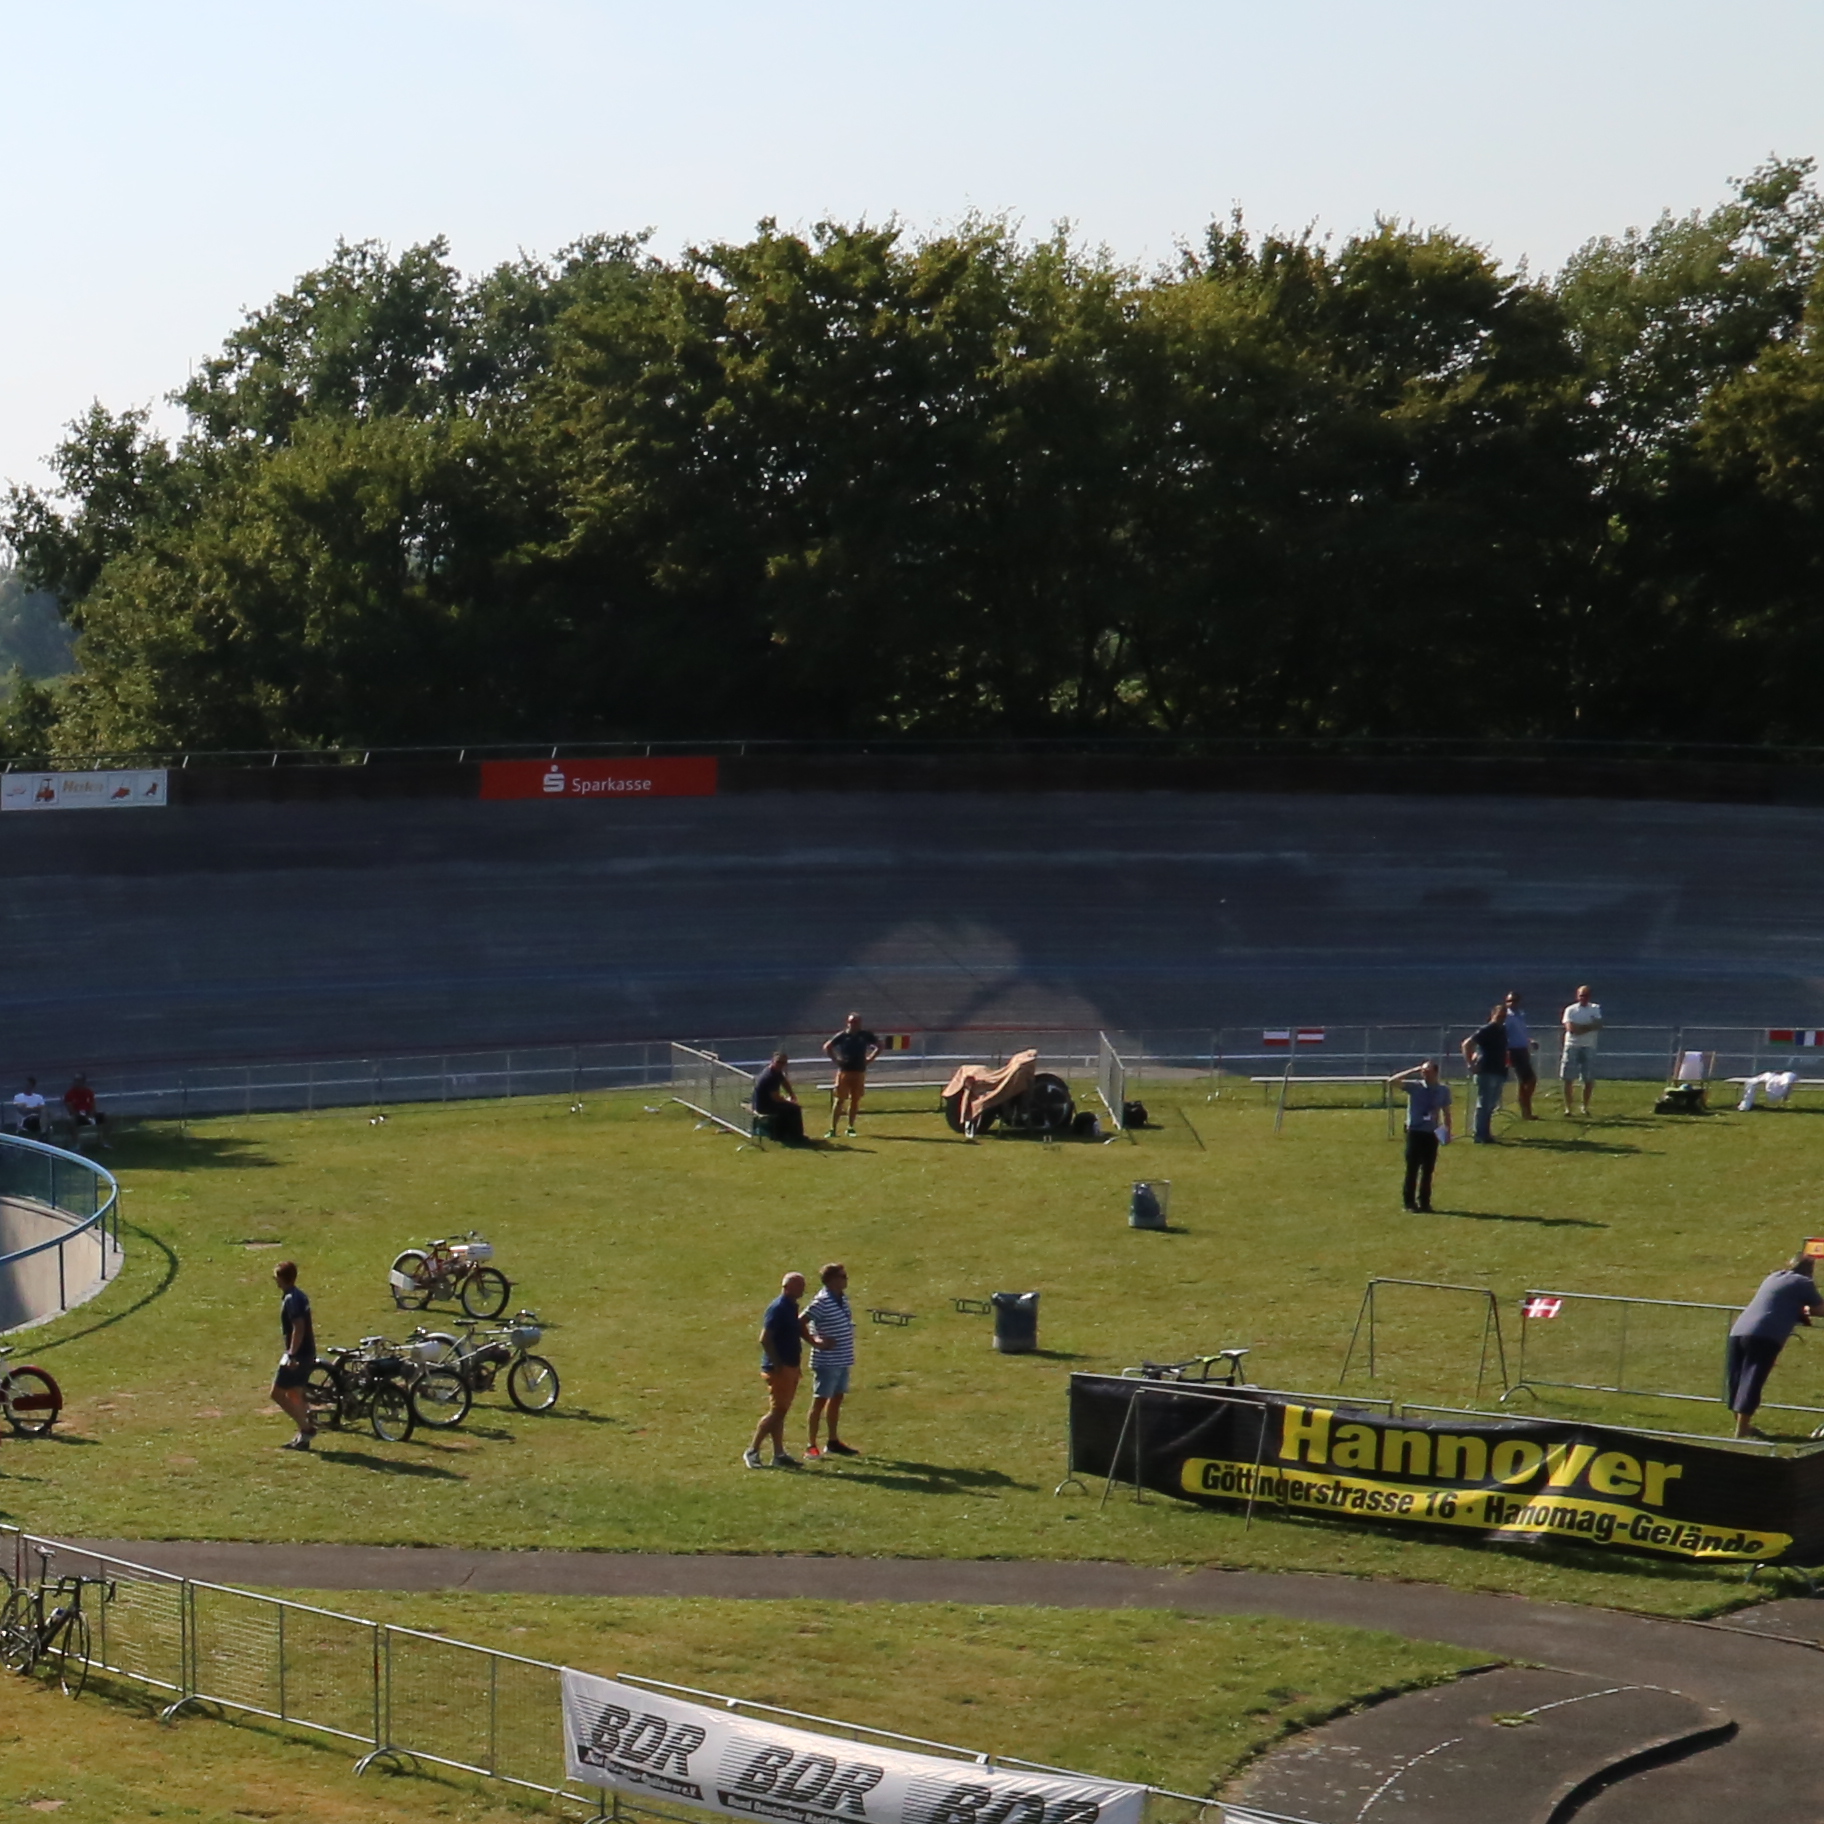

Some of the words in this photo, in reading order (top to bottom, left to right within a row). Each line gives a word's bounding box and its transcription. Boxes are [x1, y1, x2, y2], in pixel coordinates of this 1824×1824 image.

[572, 776, 652, 794] Sparkasse
[1278, 1404, 1683, 1507] Hannover
[1200, 1461, 1413, 1517] Göttingerstrasse
[1425, 1491, 1457, 1519] 16
[1483, 1495, 1765, 1556] Hanomag-Gelände
[584, 1702, 706, 1777] BDR
[732, 1744, 884, 1815] BDR
